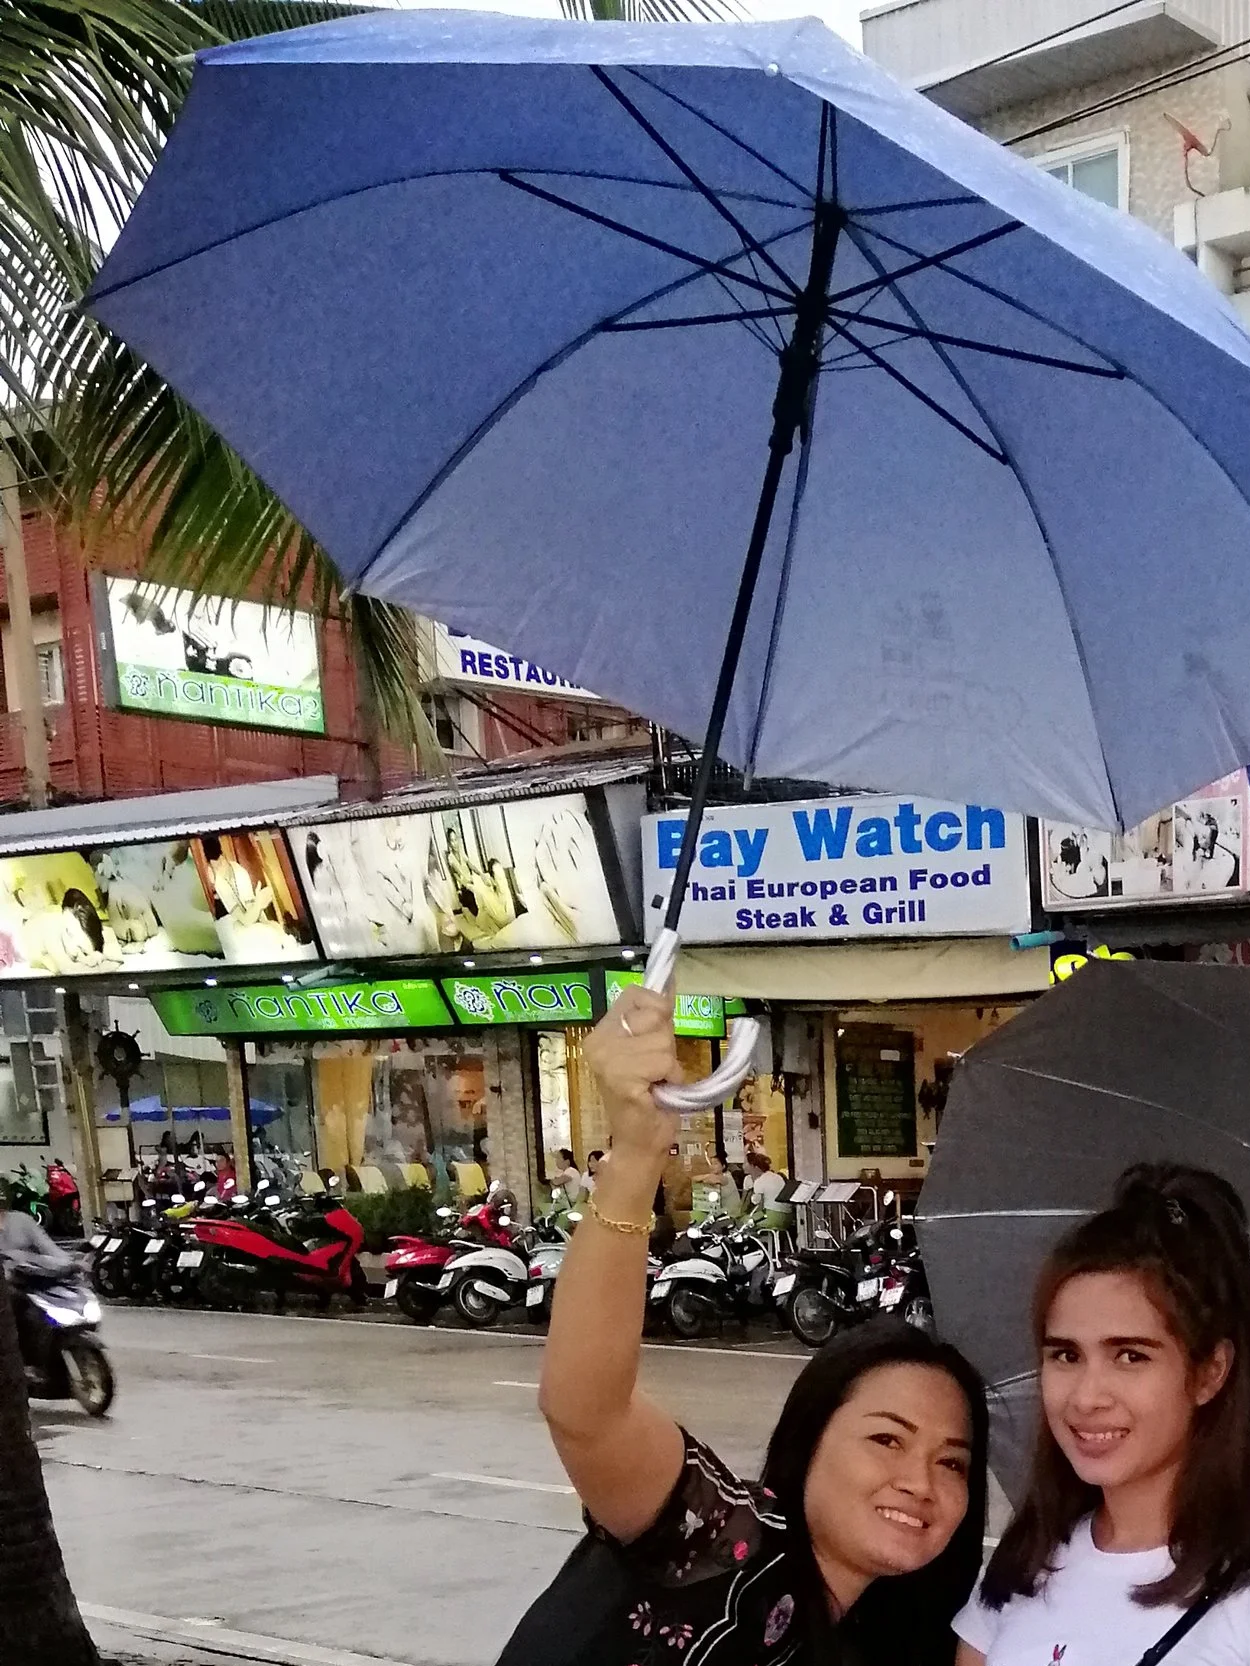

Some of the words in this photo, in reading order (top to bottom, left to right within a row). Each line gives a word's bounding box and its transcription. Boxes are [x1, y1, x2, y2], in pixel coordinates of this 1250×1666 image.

[459, 649, 581, 689] RESTAU
[657, 819, 769, 878] Bay
[792, 803, 1006, 862] Watch
[686, 879, 735, 902] hai
[747, 874, 898, 900] European
[909, 864, 991, 890] Food
[735, 905, 816, 930] Steak
[829, 903, 849, 926] &
[863, 899, 926, 925] Grill
